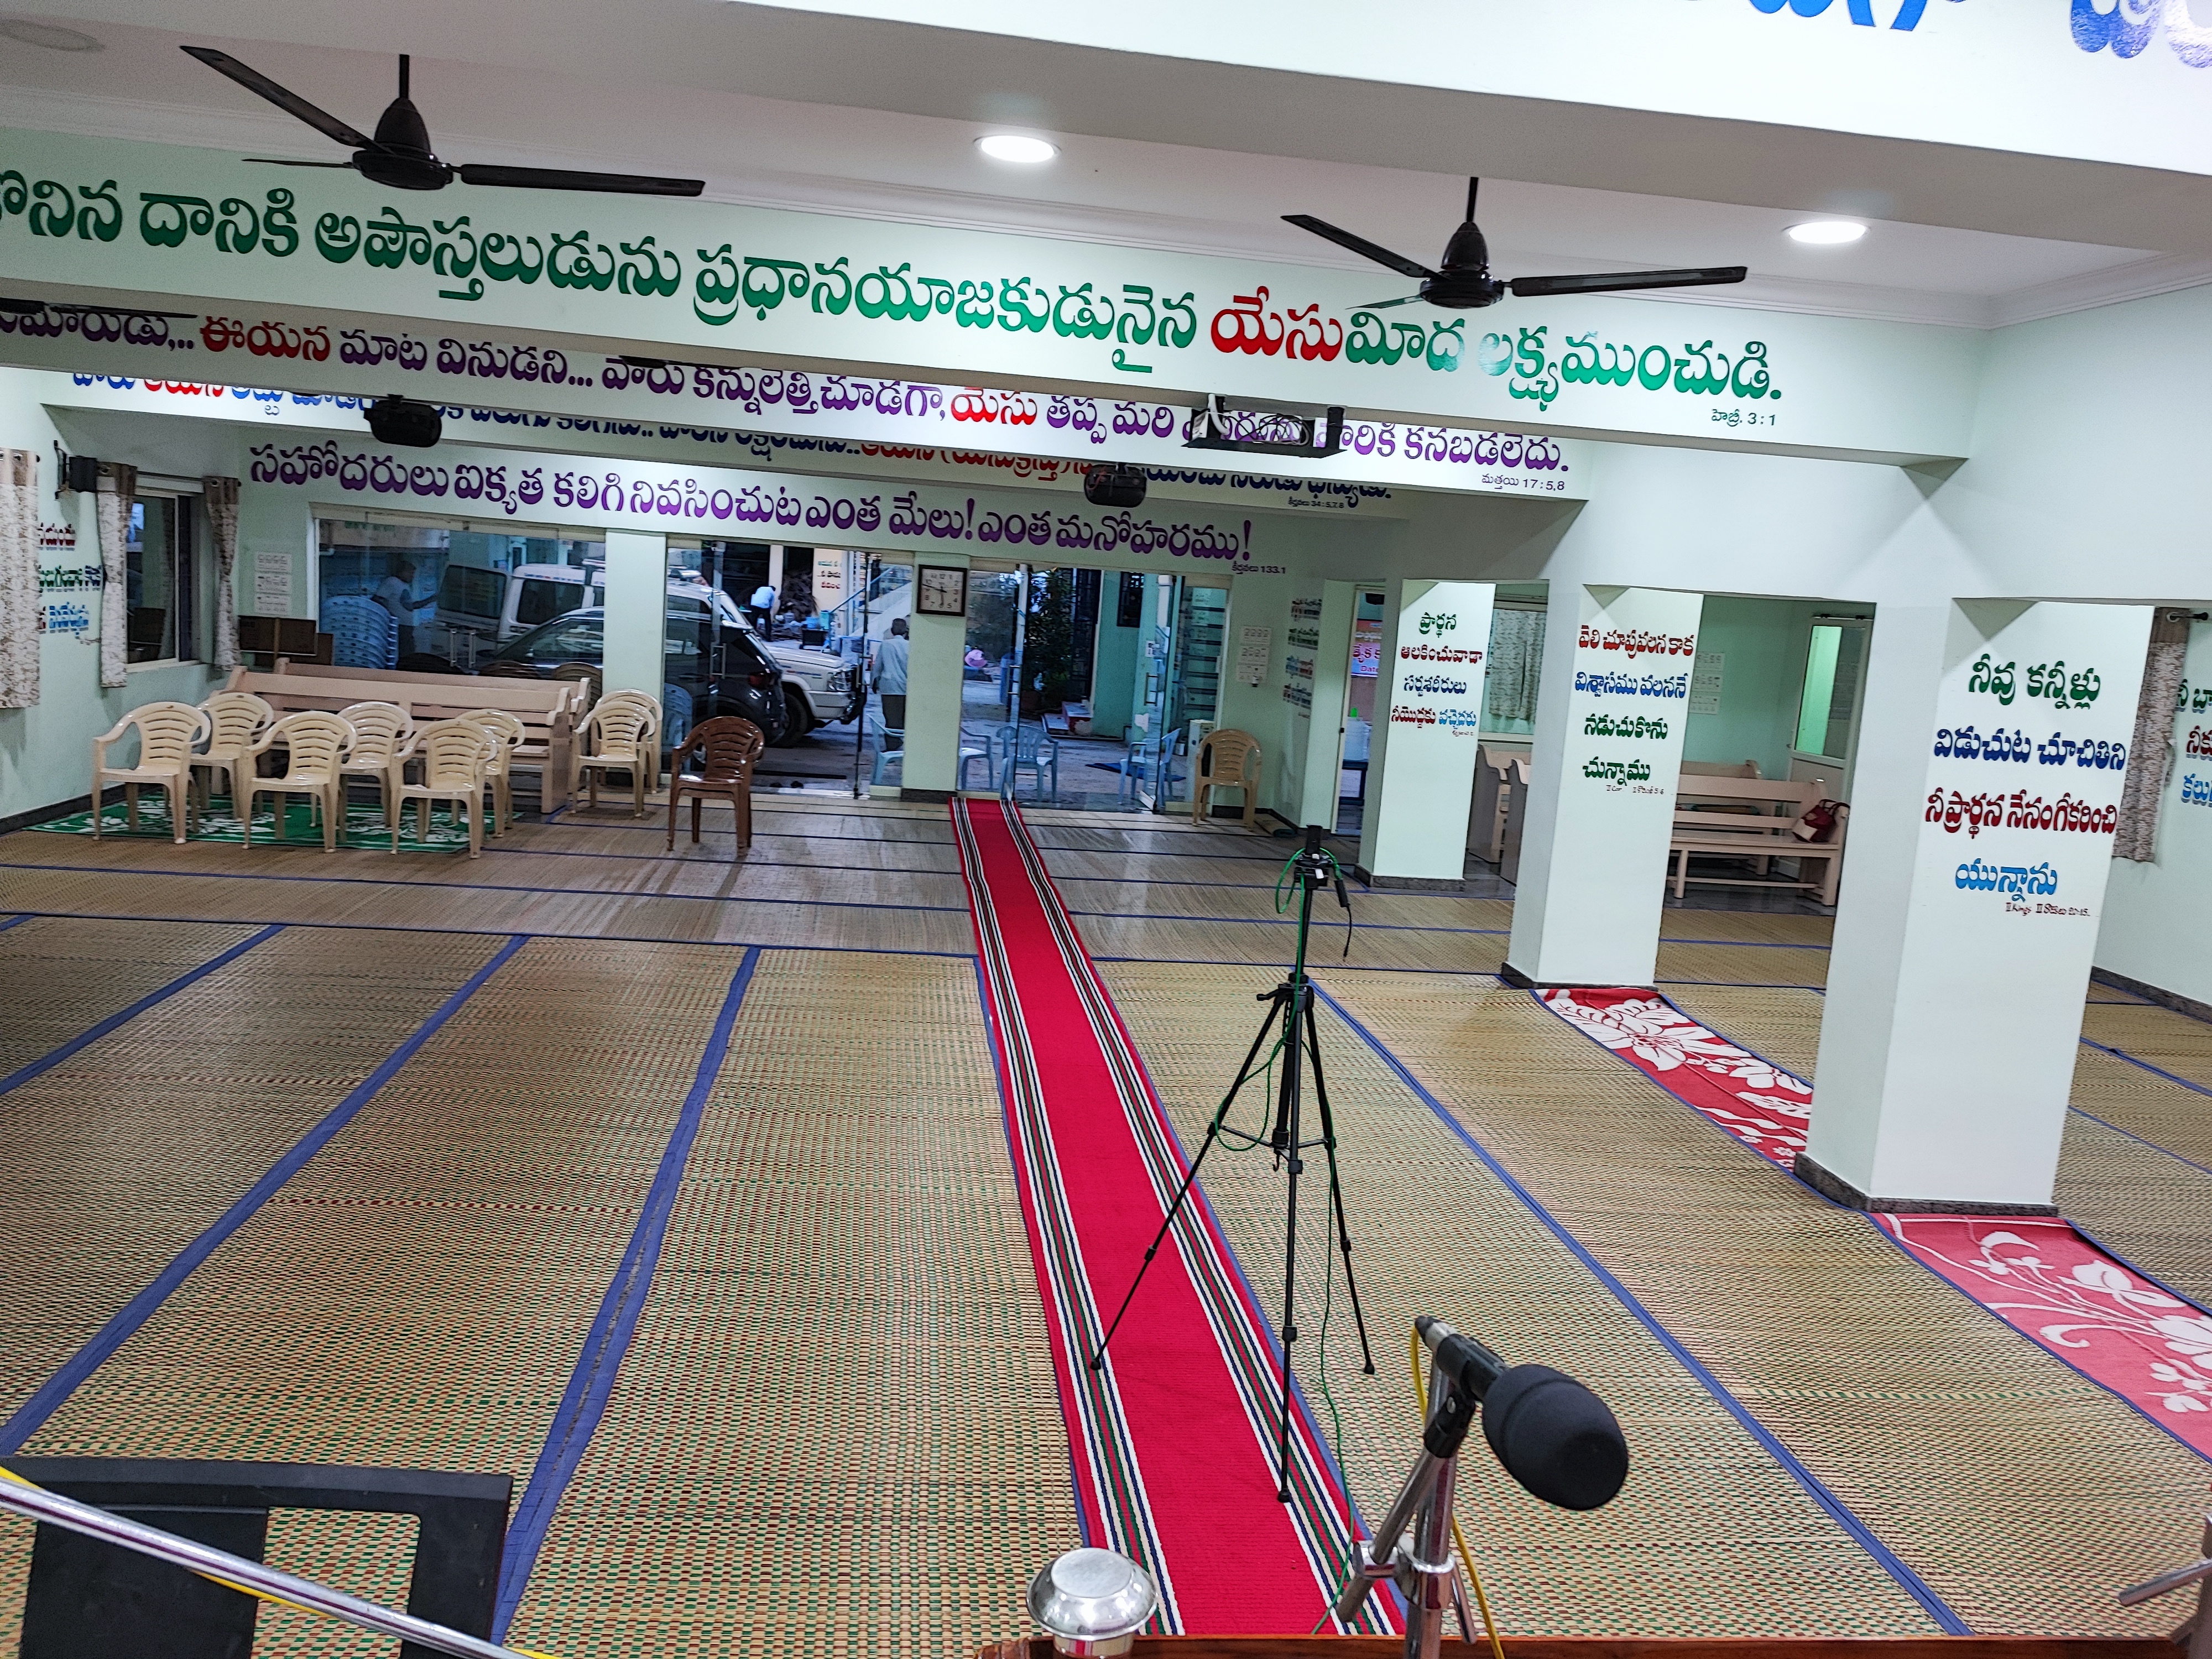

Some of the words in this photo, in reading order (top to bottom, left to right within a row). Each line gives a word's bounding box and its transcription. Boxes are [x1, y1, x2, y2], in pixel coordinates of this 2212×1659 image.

[139, 187, 299, 257] దానికి
[693, 244, 1197, 373] ప్రధానయాజకుడునైన
[340, 328, 427, 372] మాట
[1047, 395, 1107, 444] తప్ప
[1113, 400, 1173, 438] మరి
[250, 440, 448, 497] సహోదరులు
[455, 463, 543, 515] ఐక్యత
[554, 472, 623, 512] కలిగి
[630, 479, 802, 526] నివసించుట
[805, 495, 881, 532] ఎంత
[978, 510, 1051, 545] ఎంత
[1481, 473, 1519, 490] మత్తయి
[1418, 612, 1456, 638] ప్రార్థన
[1575, 671, 1638, 697] విశ్వాసము
[1969, 653, 2016, 706] నీవు
[1584, 713, 1668, 740] నడుచుకొను
[1934, 725, 2031, 763] విడుచుట
[2037, 732, 2126, 771] చూచితిని
[1582, 757, 1651, 786] చున్నాము
[1955, 858, 2058, 902] యున్నాను
